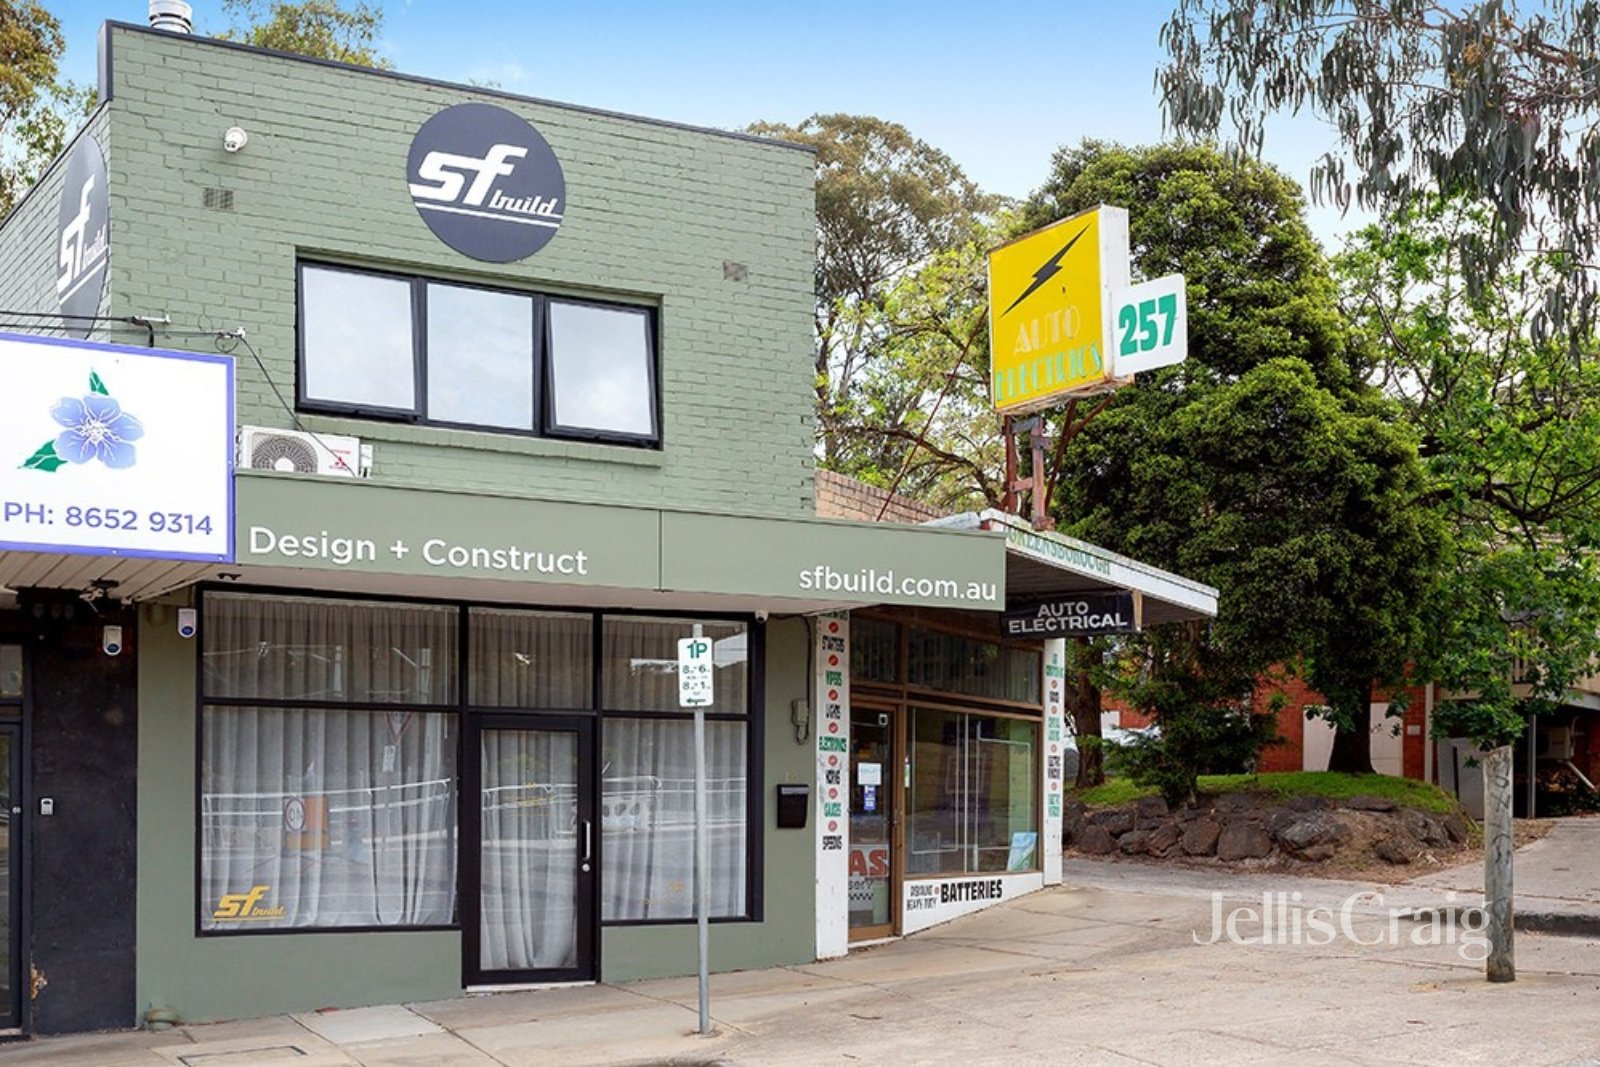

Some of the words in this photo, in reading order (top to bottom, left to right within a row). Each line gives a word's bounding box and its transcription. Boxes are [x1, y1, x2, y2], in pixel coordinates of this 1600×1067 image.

[488, 189, 558, 215] build
[1014, 305, 1081, 356] AUTO
[1118, 293, 1177, 357] 257
[4, 502, 53, 524] PH:
[65, 506, 138, 530] 8652
[149, 511, 213, 535] 9314
[250, 526, 376, 564] Design
[390, 539, 410, 559] +
[422, 538, 587, 575] Construct
[799, 565, 997, 600] sfbuild.com.au
[1008, 613, 1128, 634] ELECTRICAL
[1037, 601, 1089, 618] AUTO
[686, 642, 707, 658] 1P
[941, 879, 1003, 903] BATTERIES
